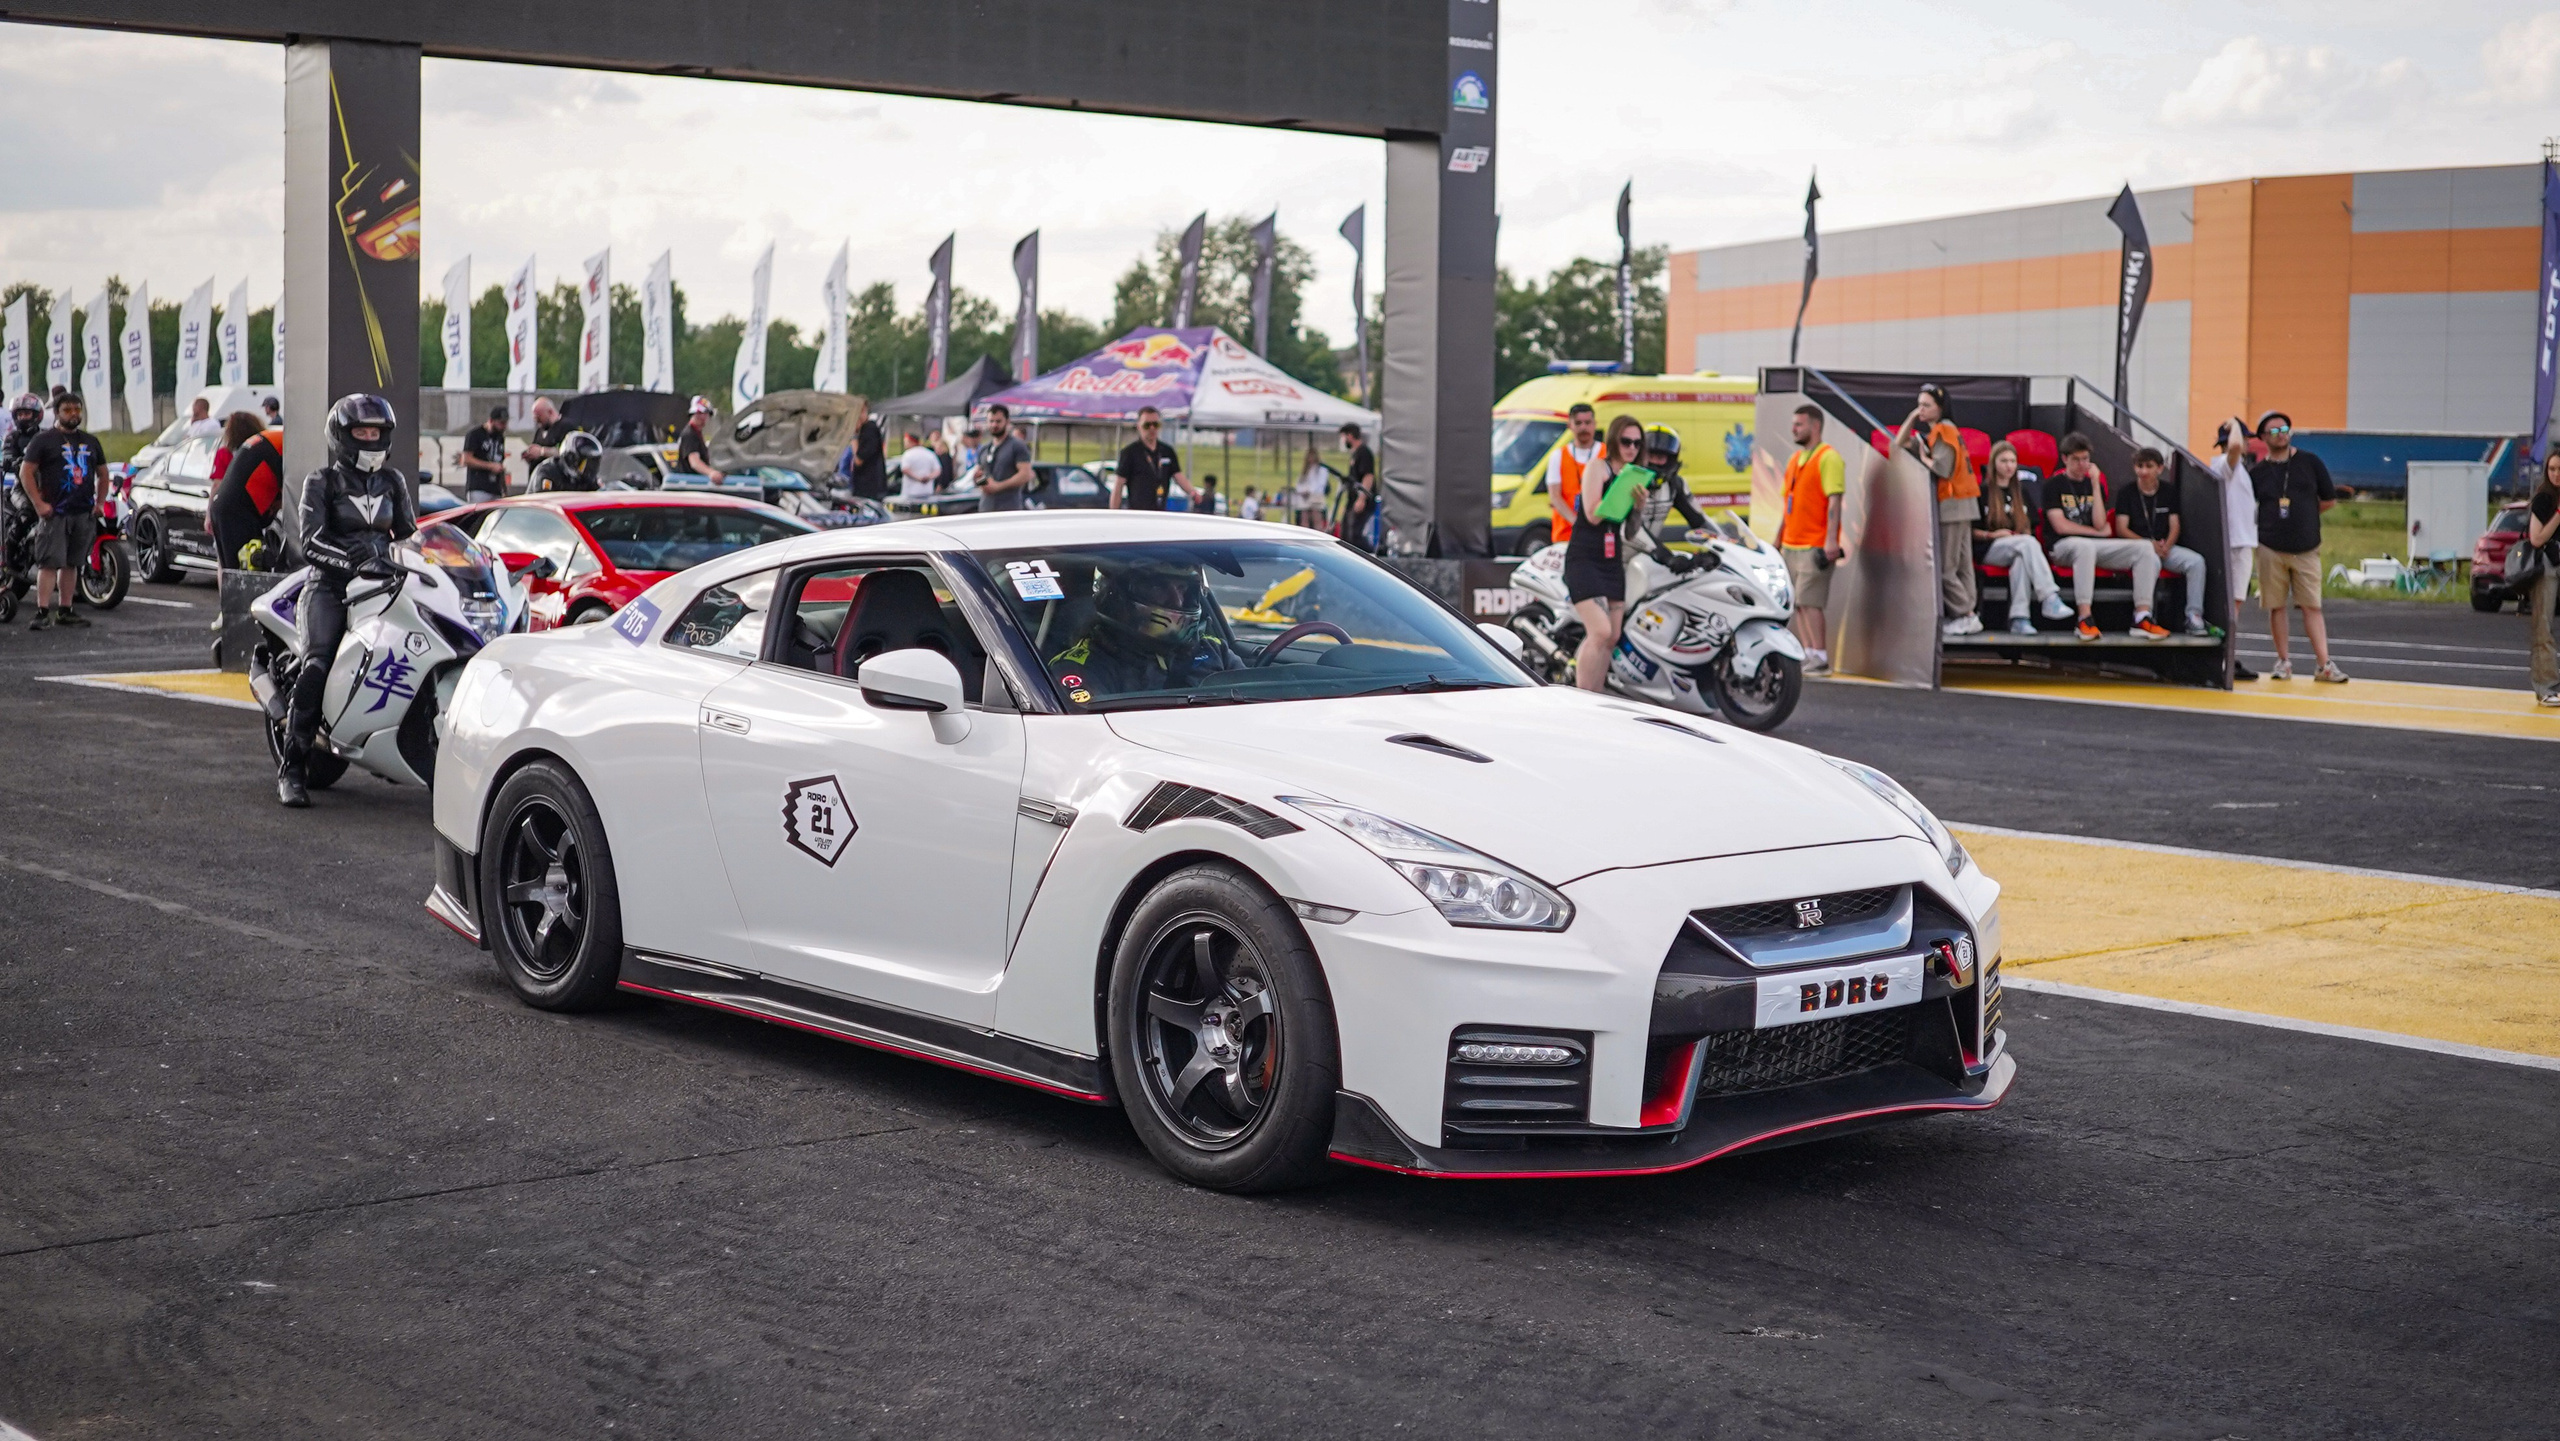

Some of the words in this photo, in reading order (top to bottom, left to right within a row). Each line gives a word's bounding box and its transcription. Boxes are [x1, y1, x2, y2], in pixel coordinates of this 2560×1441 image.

[1005, 560, 1060, 580] 21
[623, 609, 649, 638] ВТБ
[1629, 651, 1648, 673] ВТБ
[363, 646, 417, 714] 隼
[811, 804, 835, 836] 21
[1796, 898, 1821, 911] GT
